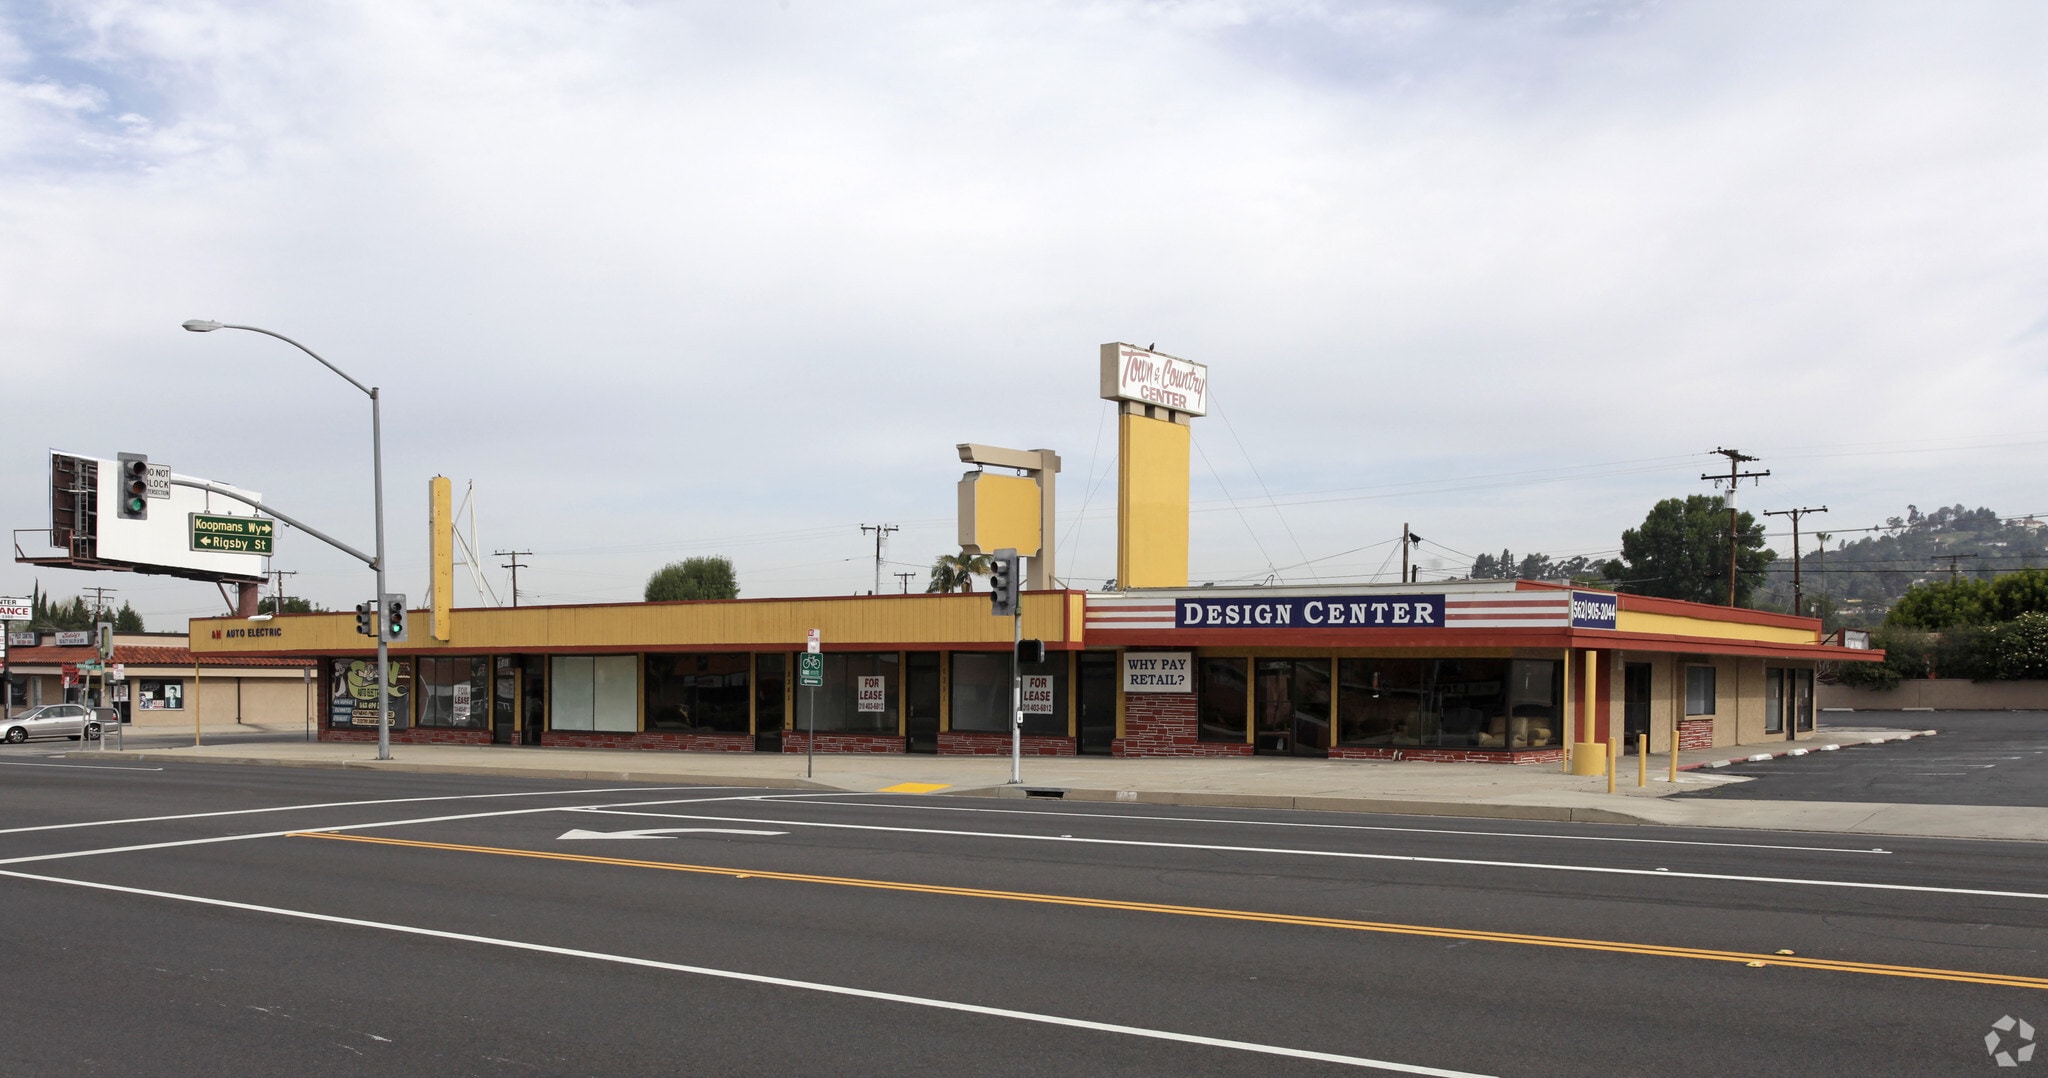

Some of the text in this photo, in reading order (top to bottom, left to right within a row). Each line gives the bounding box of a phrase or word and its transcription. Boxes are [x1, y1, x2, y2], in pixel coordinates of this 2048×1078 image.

[1121, 350, 1205, 408] Town & Country
[1140, 384, 1187, 408] CENTER
[156, 468, 169, 478] NOT
[195, 518, 262, 536] Koopmans Wy
[213, 536, 266, 551] Rigsby St
[1183, 601, 1434, 625] DESIGN CENTER
[226, 629, 245, 638] AUTO
[247, 627, 282, 638] ELECTRIC
[1128, 659, 1187, 670] WHY PAY
[864, 678, 880, 688] FOR
[1030, 677, 1047, 688] FOR
[1130, 674, 1185, 686] RETAIL?
[457, 686, 468, 695] FOR
[859, 690, 883, 700] LEASE
[1023, 690, 1051, 701] LEASE
[454, 696, 470, 705] LEASE
